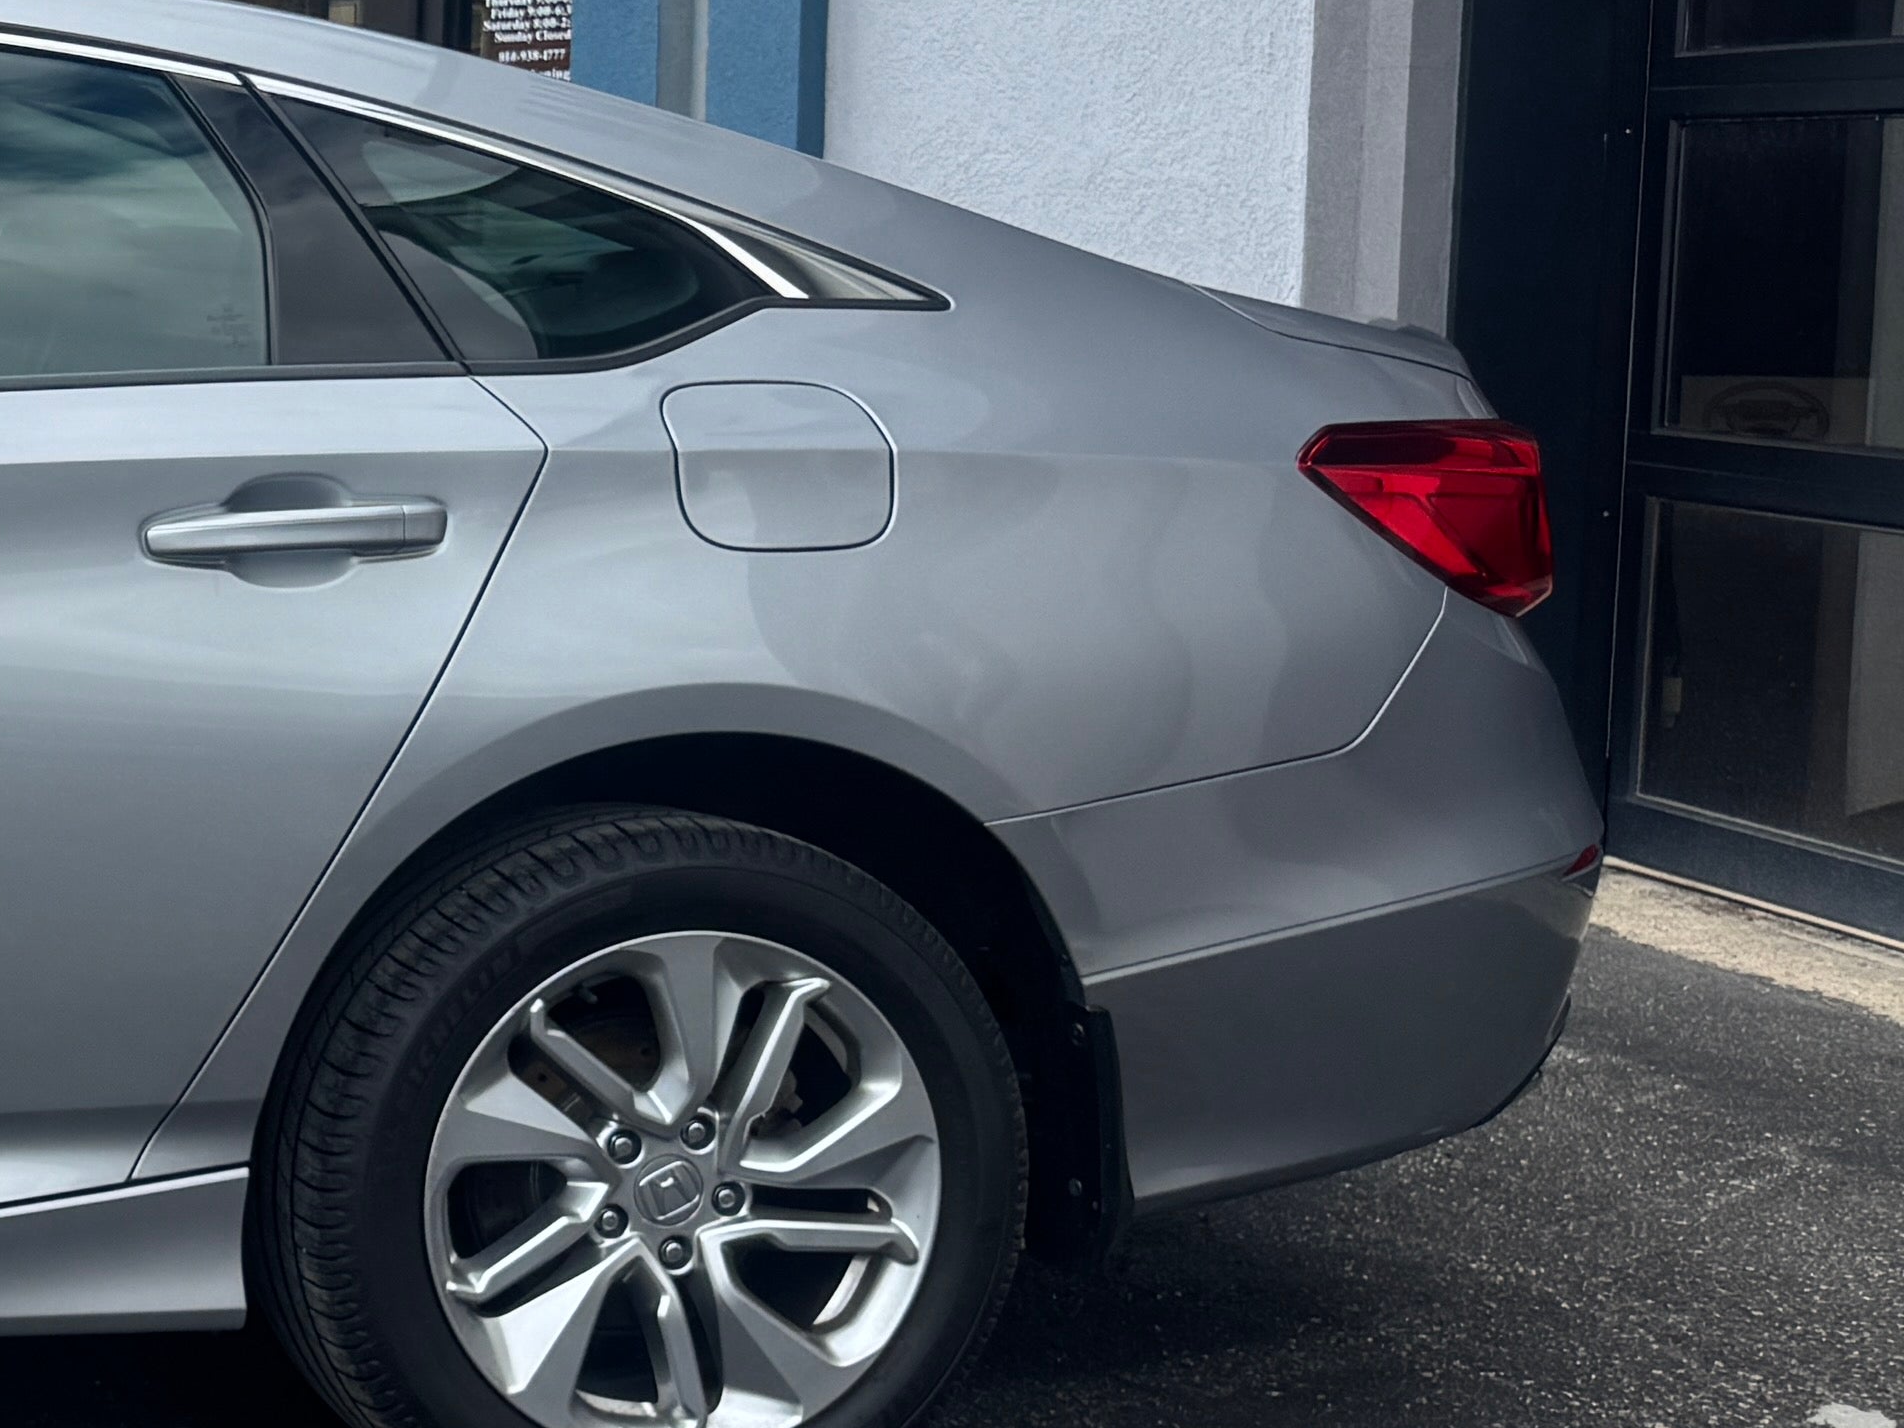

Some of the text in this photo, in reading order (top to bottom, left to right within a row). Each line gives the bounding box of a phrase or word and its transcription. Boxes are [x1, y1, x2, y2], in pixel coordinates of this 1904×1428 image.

[491, 7, 525, 21] Friday
[482, 19, 531, 33] Saturday
[494, 29, 571, 45] Sunday Closed
